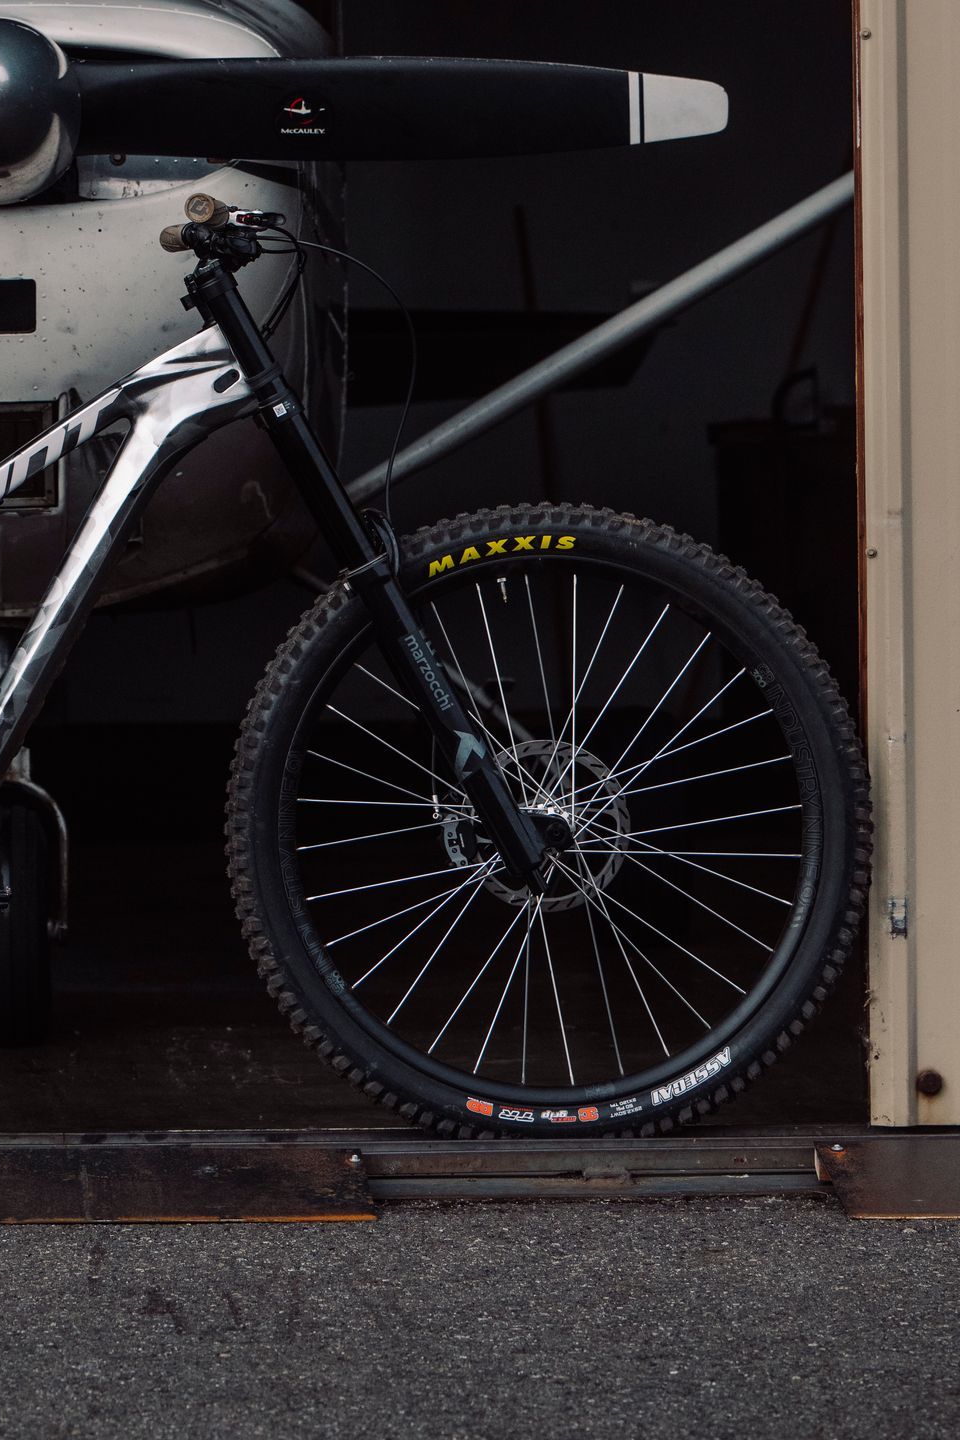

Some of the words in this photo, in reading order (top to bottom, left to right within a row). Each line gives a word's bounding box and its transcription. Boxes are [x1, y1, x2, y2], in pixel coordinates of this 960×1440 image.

[427, 534, 577, 578] MAXXIS
[403, 633, 455, 712] marzocchi
[651, 1046, 731, 1106] ASSEGAI
